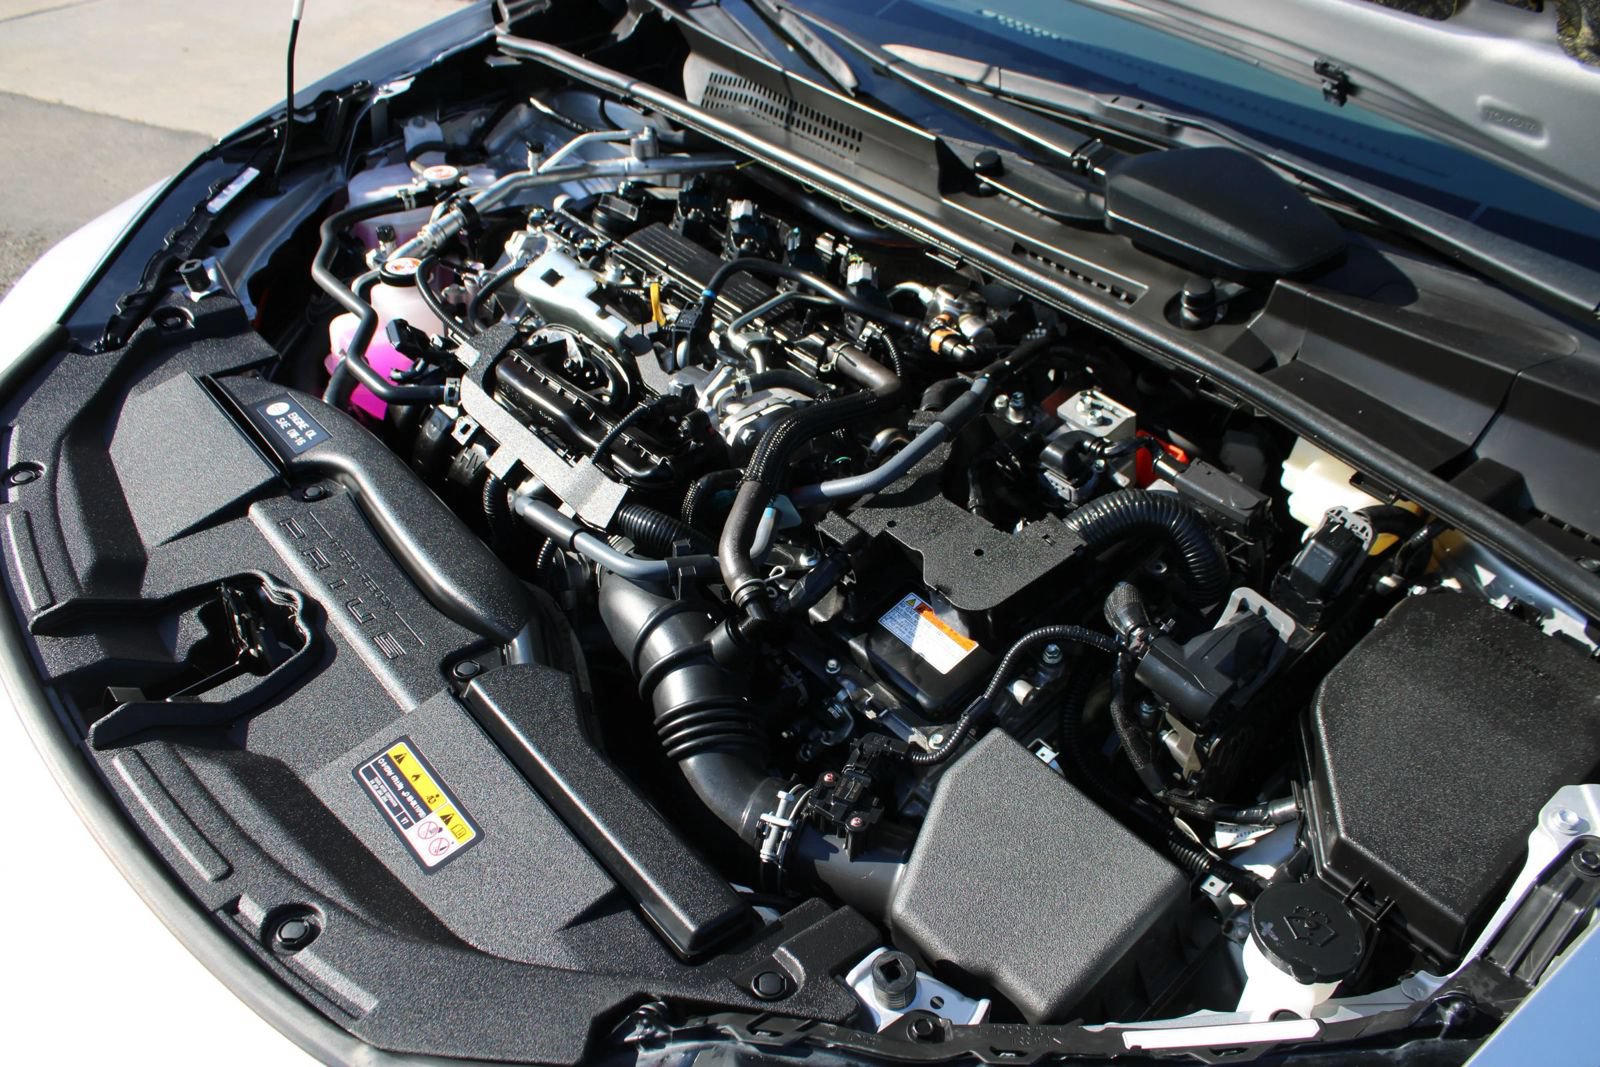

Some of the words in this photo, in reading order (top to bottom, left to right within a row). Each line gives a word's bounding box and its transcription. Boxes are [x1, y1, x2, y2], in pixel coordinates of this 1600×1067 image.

[275, 417, 291, 430] SAE
[288, 411, 309, 431] ENGINE
[305, 429, 317, 440] OIL
[279, 517, 407, 660] PRIUS
